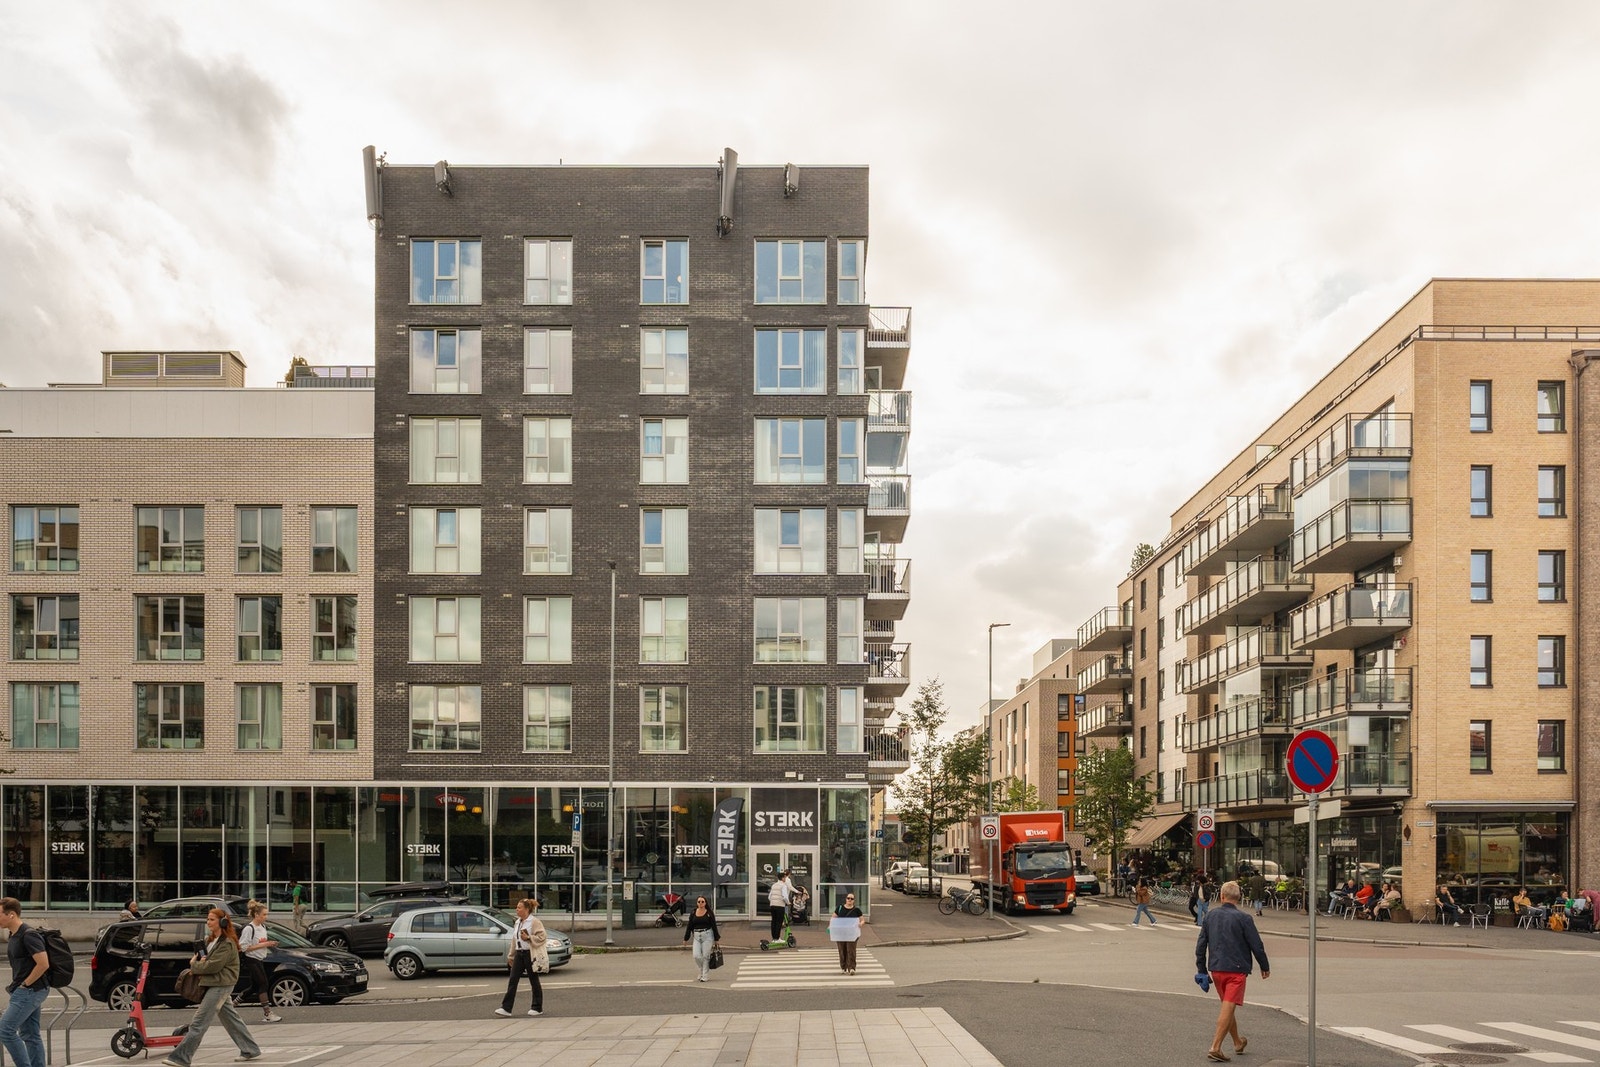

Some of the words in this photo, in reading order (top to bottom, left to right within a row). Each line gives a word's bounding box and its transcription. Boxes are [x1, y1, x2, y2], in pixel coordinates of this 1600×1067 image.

[574, 815, 580, 829] P
[754, 811, 814, 827] STERK
[986, 827, 994, 835] 30
[51, 842, 85, 851] STERK
[717, 809, 737, 876] STERK
[407, 844, 441, 854] STERK
[541, 844, 575, 854] STERK
[675, 845, 709, 854] STERK
